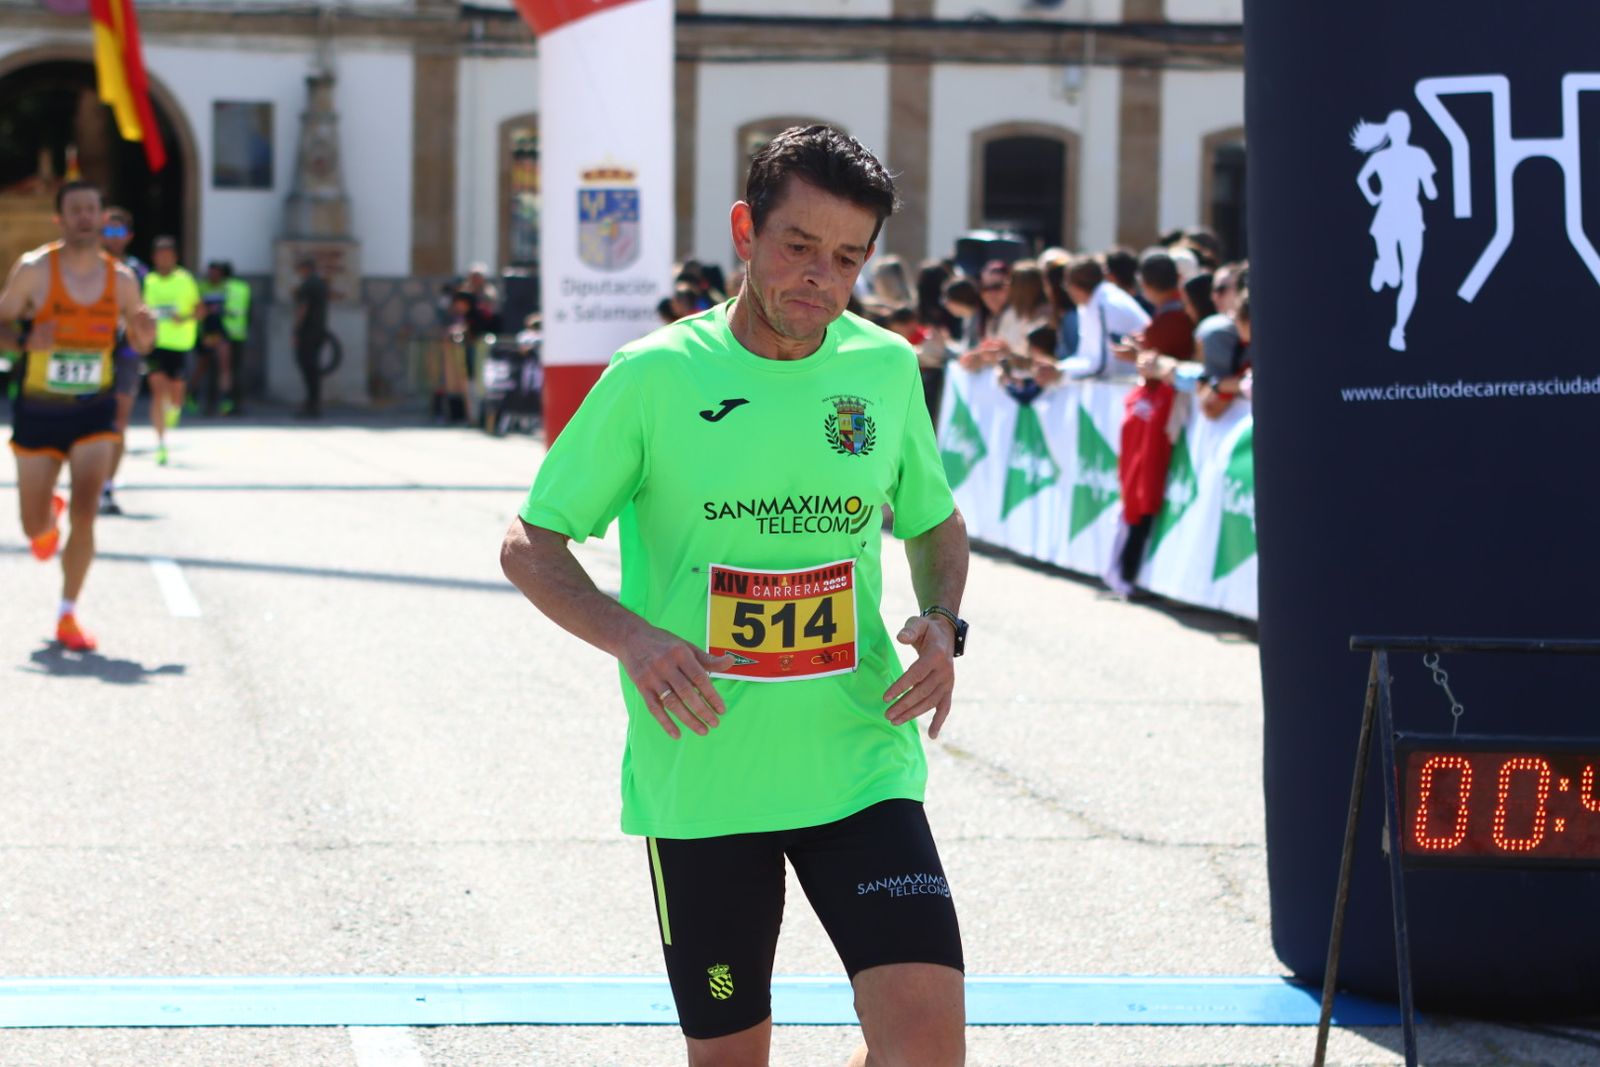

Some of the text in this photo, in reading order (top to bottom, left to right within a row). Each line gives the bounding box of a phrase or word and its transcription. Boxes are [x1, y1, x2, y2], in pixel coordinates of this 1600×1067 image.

[704, 495, 862, 521] SANMAXIMO
[756, 515, 851, 535] TELECOM
[714, 571, 749, 594] XIV
[753, 575, 779, 586] SAN
[752, 582, 821, 598] CARRERA
[731, 596, 837, 649] 514
[857, 873, 947, 895] SANMAXIMO
[888, 884, 945, 898] TELECOM
